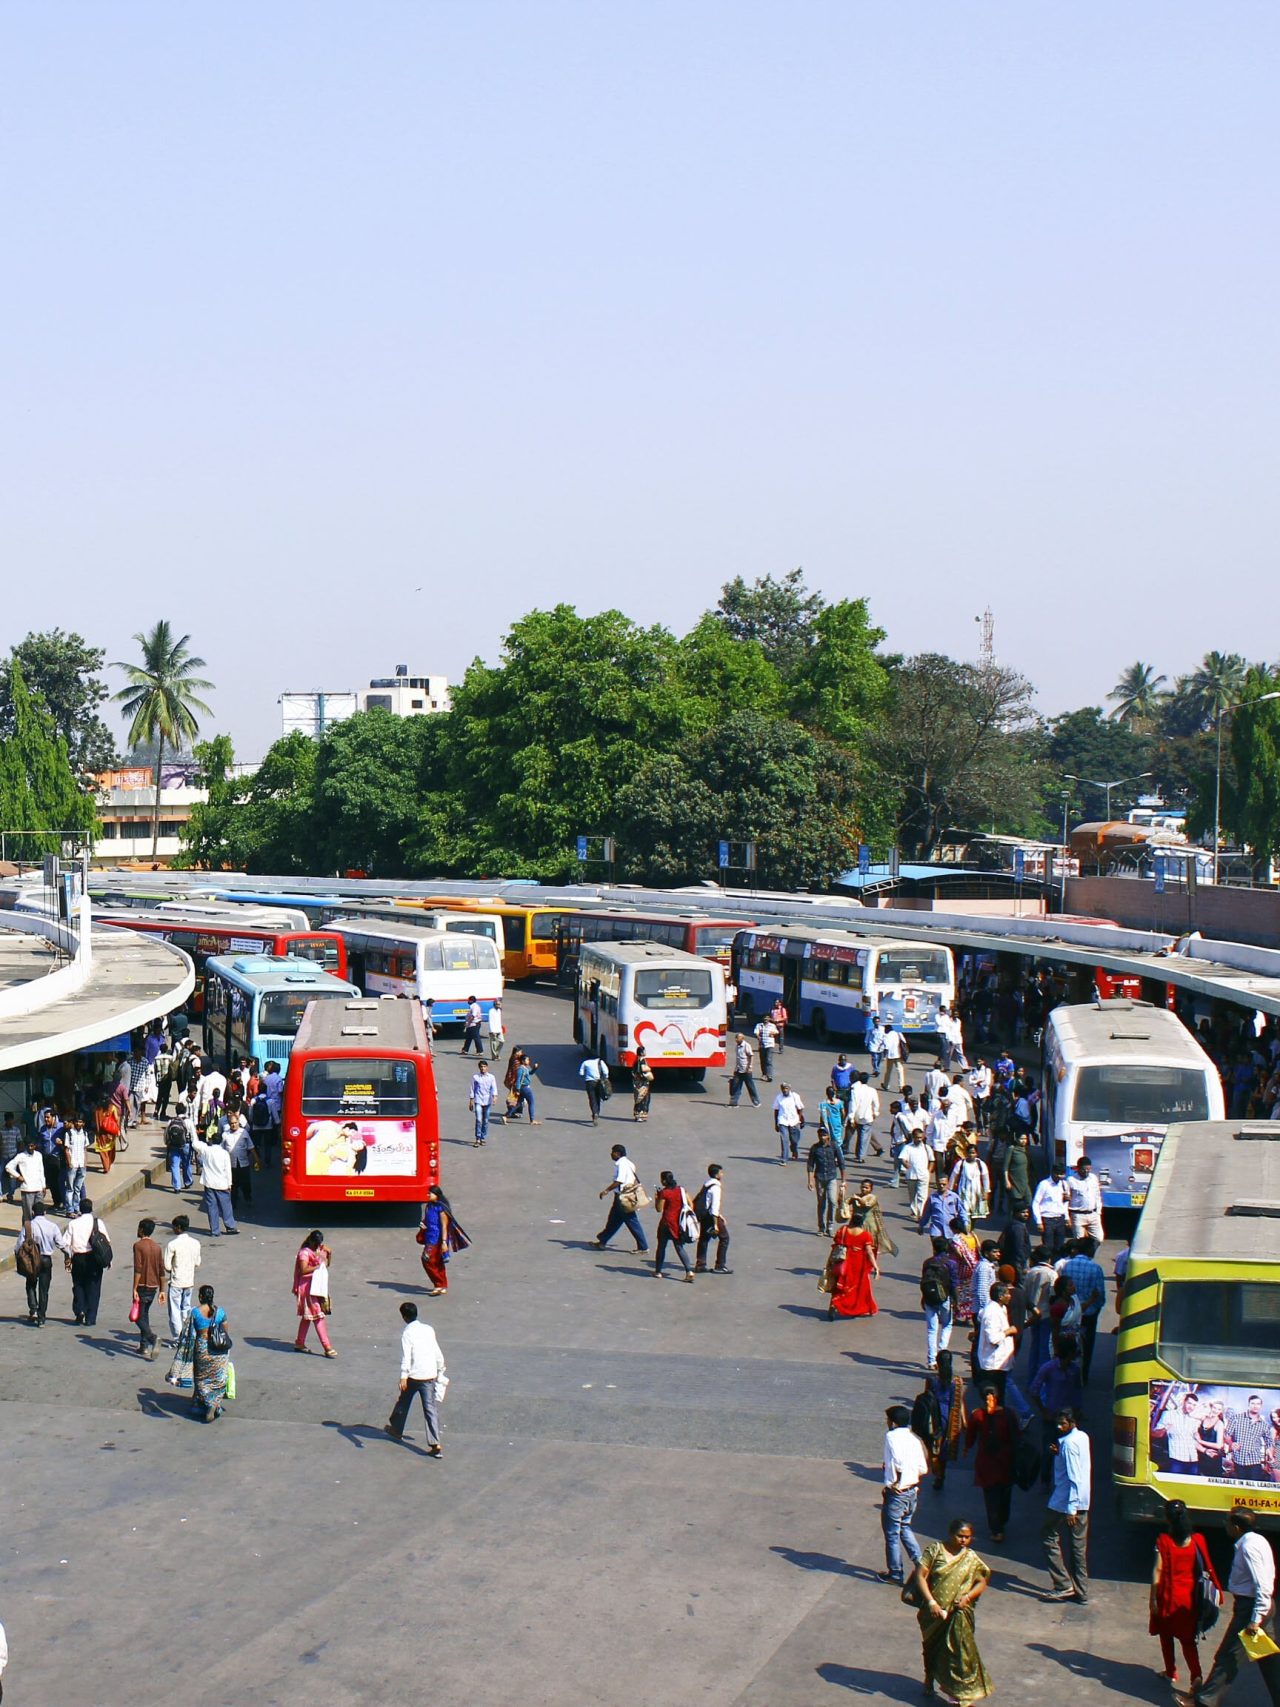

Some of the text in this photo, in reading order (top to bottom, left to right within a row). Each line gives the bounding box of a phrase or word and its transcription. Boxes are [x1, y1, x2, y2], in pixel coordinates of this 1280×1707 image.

[578, 849, 587, 859] 22
[720, 855, 729, 866] 22
[1208, 1477, 1237, 1485] AVAILABLE
[1234, 1497, 1247, 1506] KA
